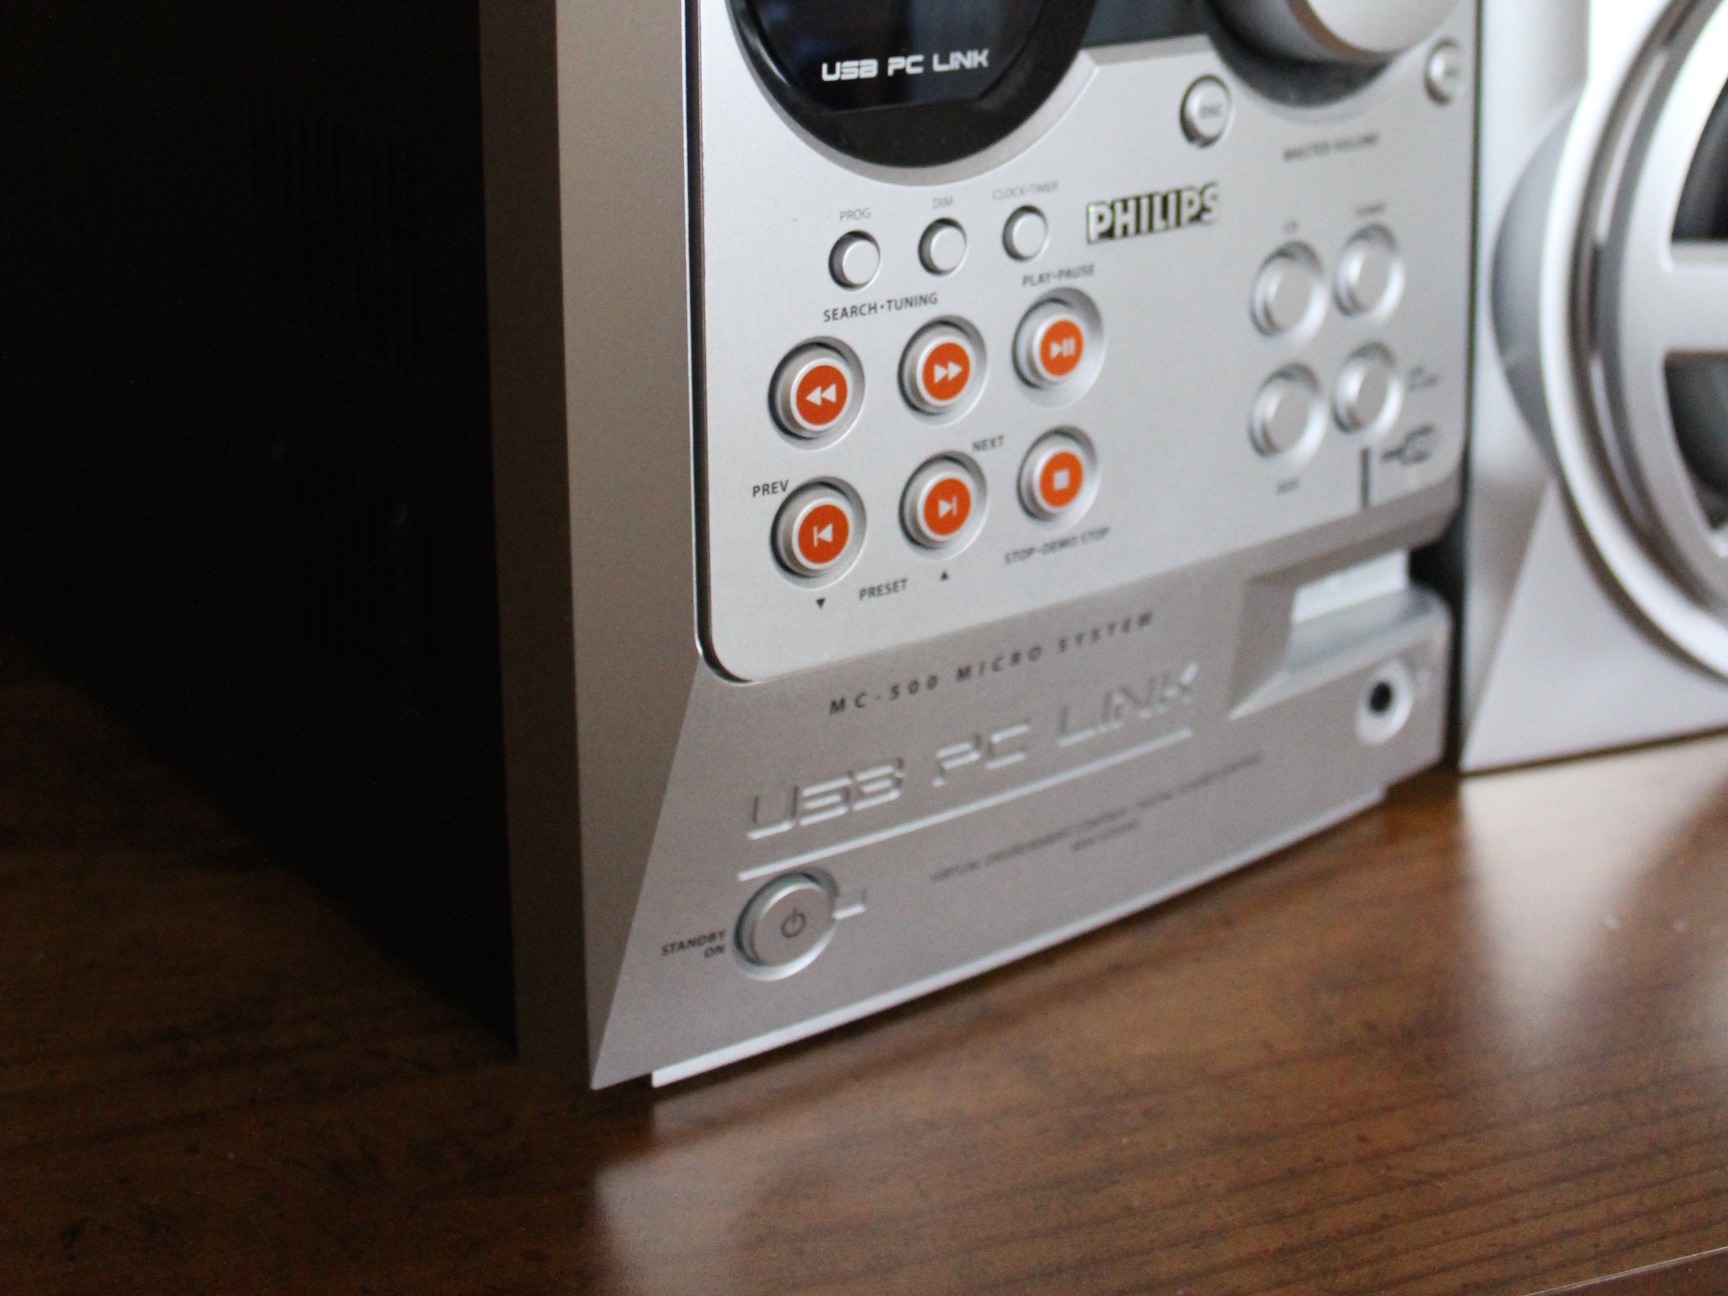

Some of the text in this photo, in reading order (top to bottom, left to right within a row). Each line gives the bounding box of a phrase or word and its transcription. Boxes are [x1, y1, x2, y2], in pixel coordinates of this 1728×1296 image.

[822, 48, 990, 81] USB PC LINK
[932, 195, 954, 210] DIM
[1087, 183, 1220, 244] PHILIPS
[839, 207, 871, 223] PROG
[972, 436, 1005, 454] NEXT
[752, 479, 789, 499] PREV
[858, 579, 909, 601] PRESET
[956, 645, 1042, 681] MICRO
[1058, 611, 1154, 654] SYSTEM
[747, 757, 905, 840] USB
[933, 716, 1032, 789] PC
[1057, 661, 1198, 748] LINK
[661, 929, 727, 957] STANDBY
[703, 944, 727, 959] ON
